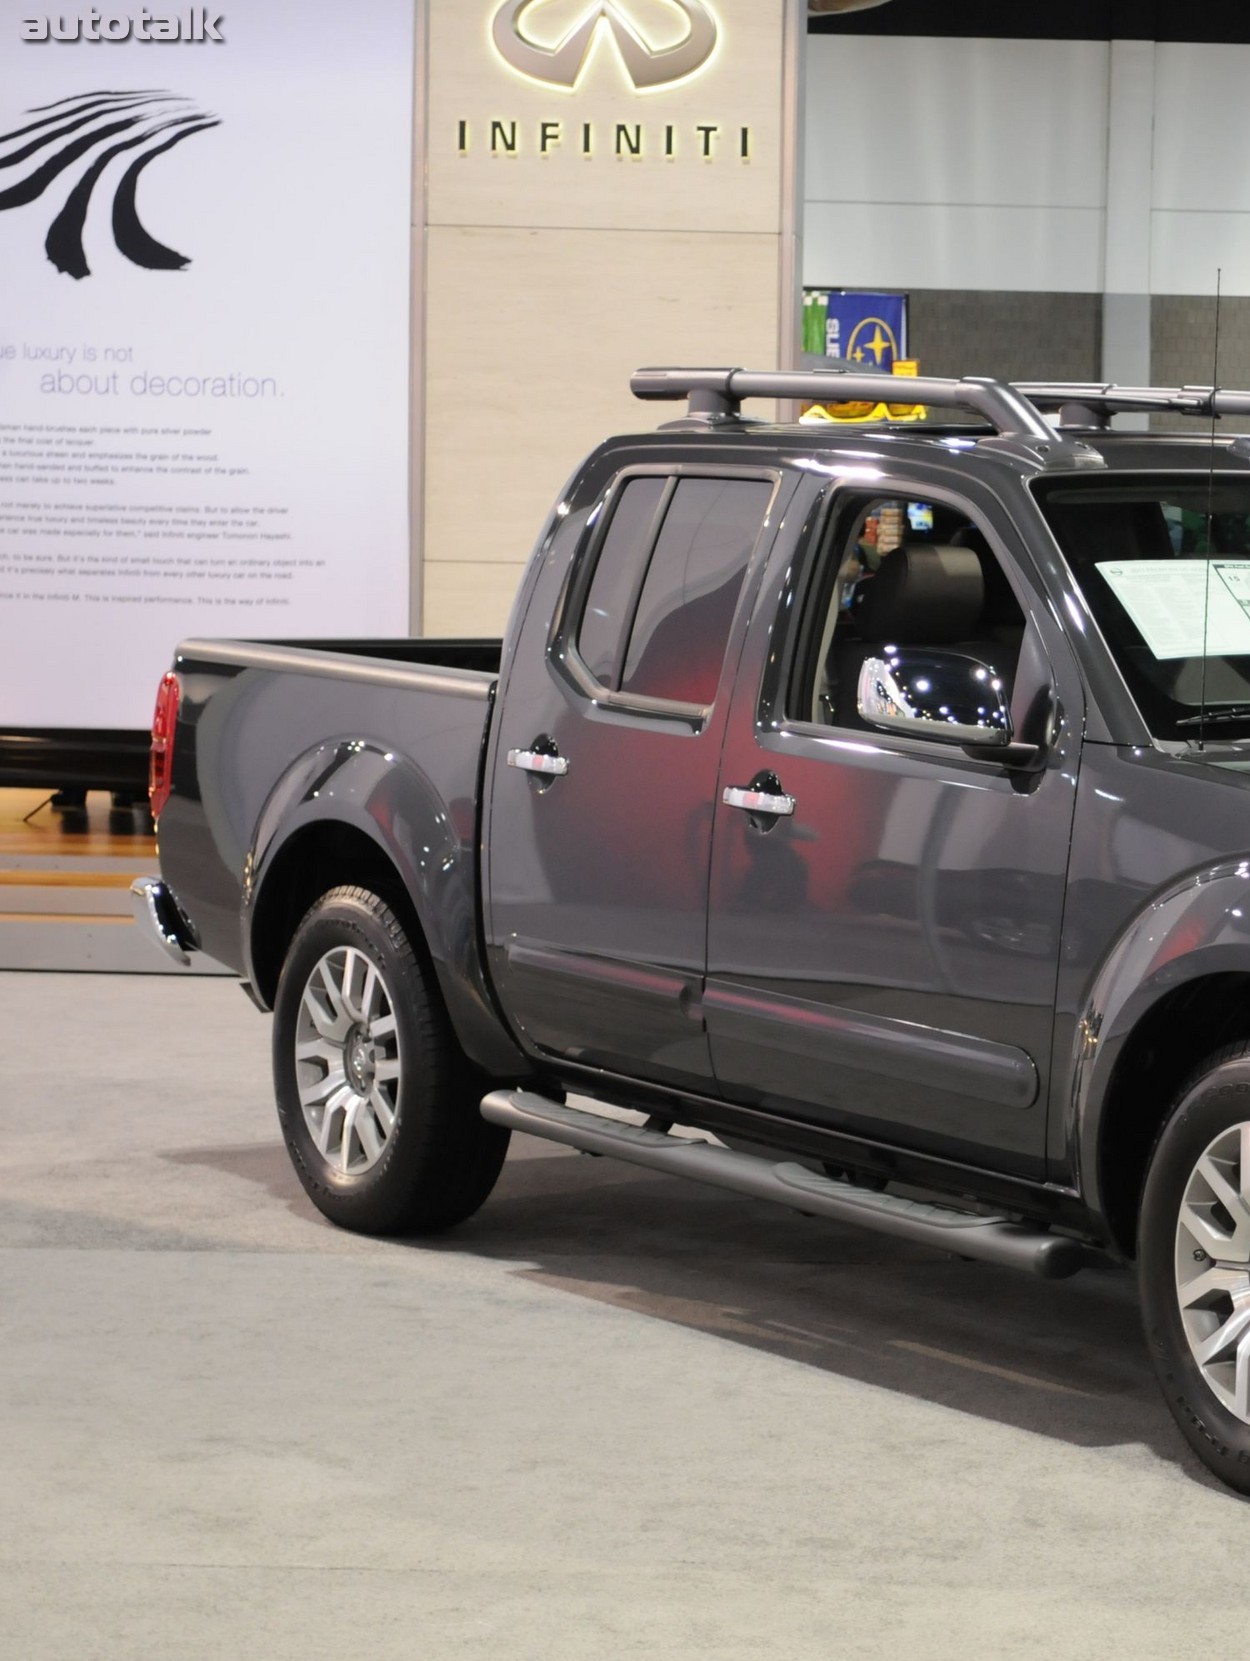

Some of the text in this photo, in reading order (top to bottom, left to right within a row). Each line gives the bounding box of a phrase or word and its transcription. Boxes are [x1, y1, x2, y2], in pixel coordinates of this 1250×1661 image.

[457, 119, 750, 158] INFINITI
[23, 341, 77, 365] luxury
[83, 343, 97, 362] is
[104, 346, 133, 363] not
[40, 368, 285, 398] about decoration.
